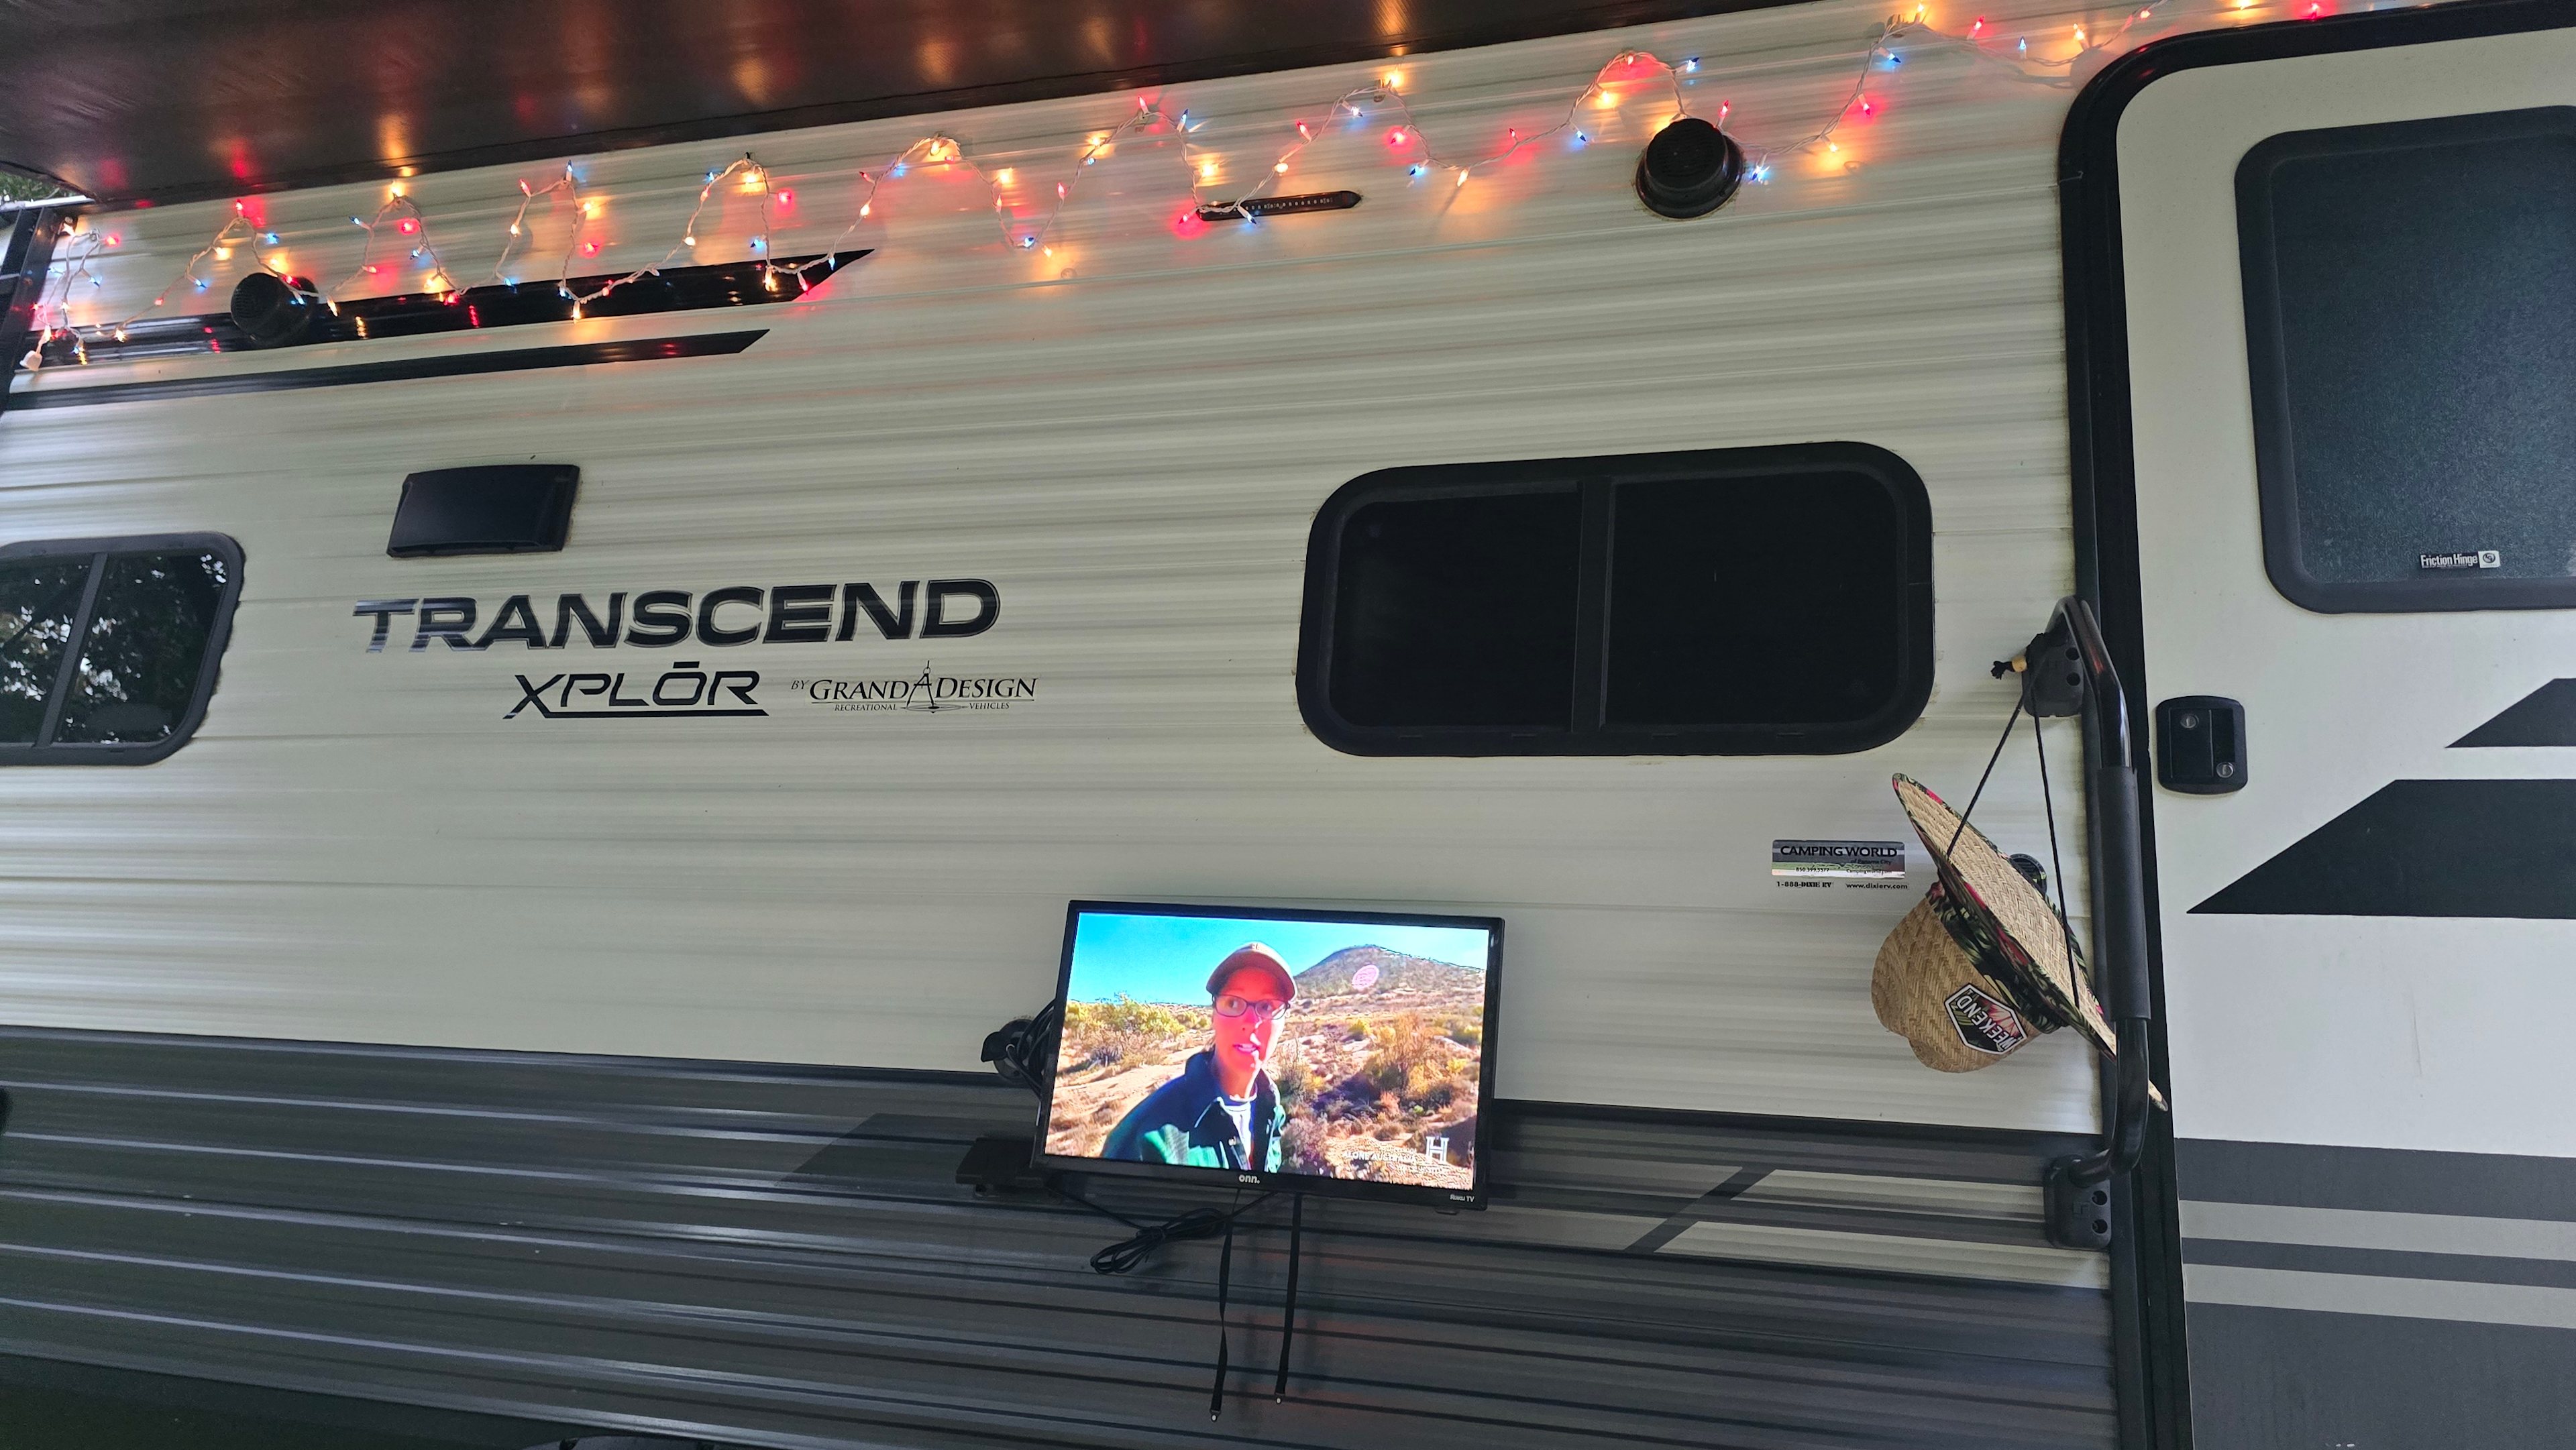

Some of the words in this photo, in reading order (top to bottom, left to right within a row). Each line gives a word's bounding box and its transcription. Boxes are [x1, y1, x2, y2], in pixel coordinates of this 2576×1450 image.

[2420, 554, 2453, 566] Friction
[2453, 553, 2478, 567] Hinge
[352, 578, 1001, 653] TRANSCEND
[791, 679, 809, 690] BY
[809, 679, 910, 701] GRAND
[934, 677, 1038, 699] DESIGN
[835, 703, 898, 712] RECREATIONAL
[969, 702, 1010, 710] VEHICLES
[1780, 846, 1842, 856] CAMPING
[1845, 846, 1898, 857] WORLD
[1956, 995, 2017, 1050] WEEKEND
[1426, 1136, 1450, 1163] H
[1238, 1174, 1260, 1184] onn.
